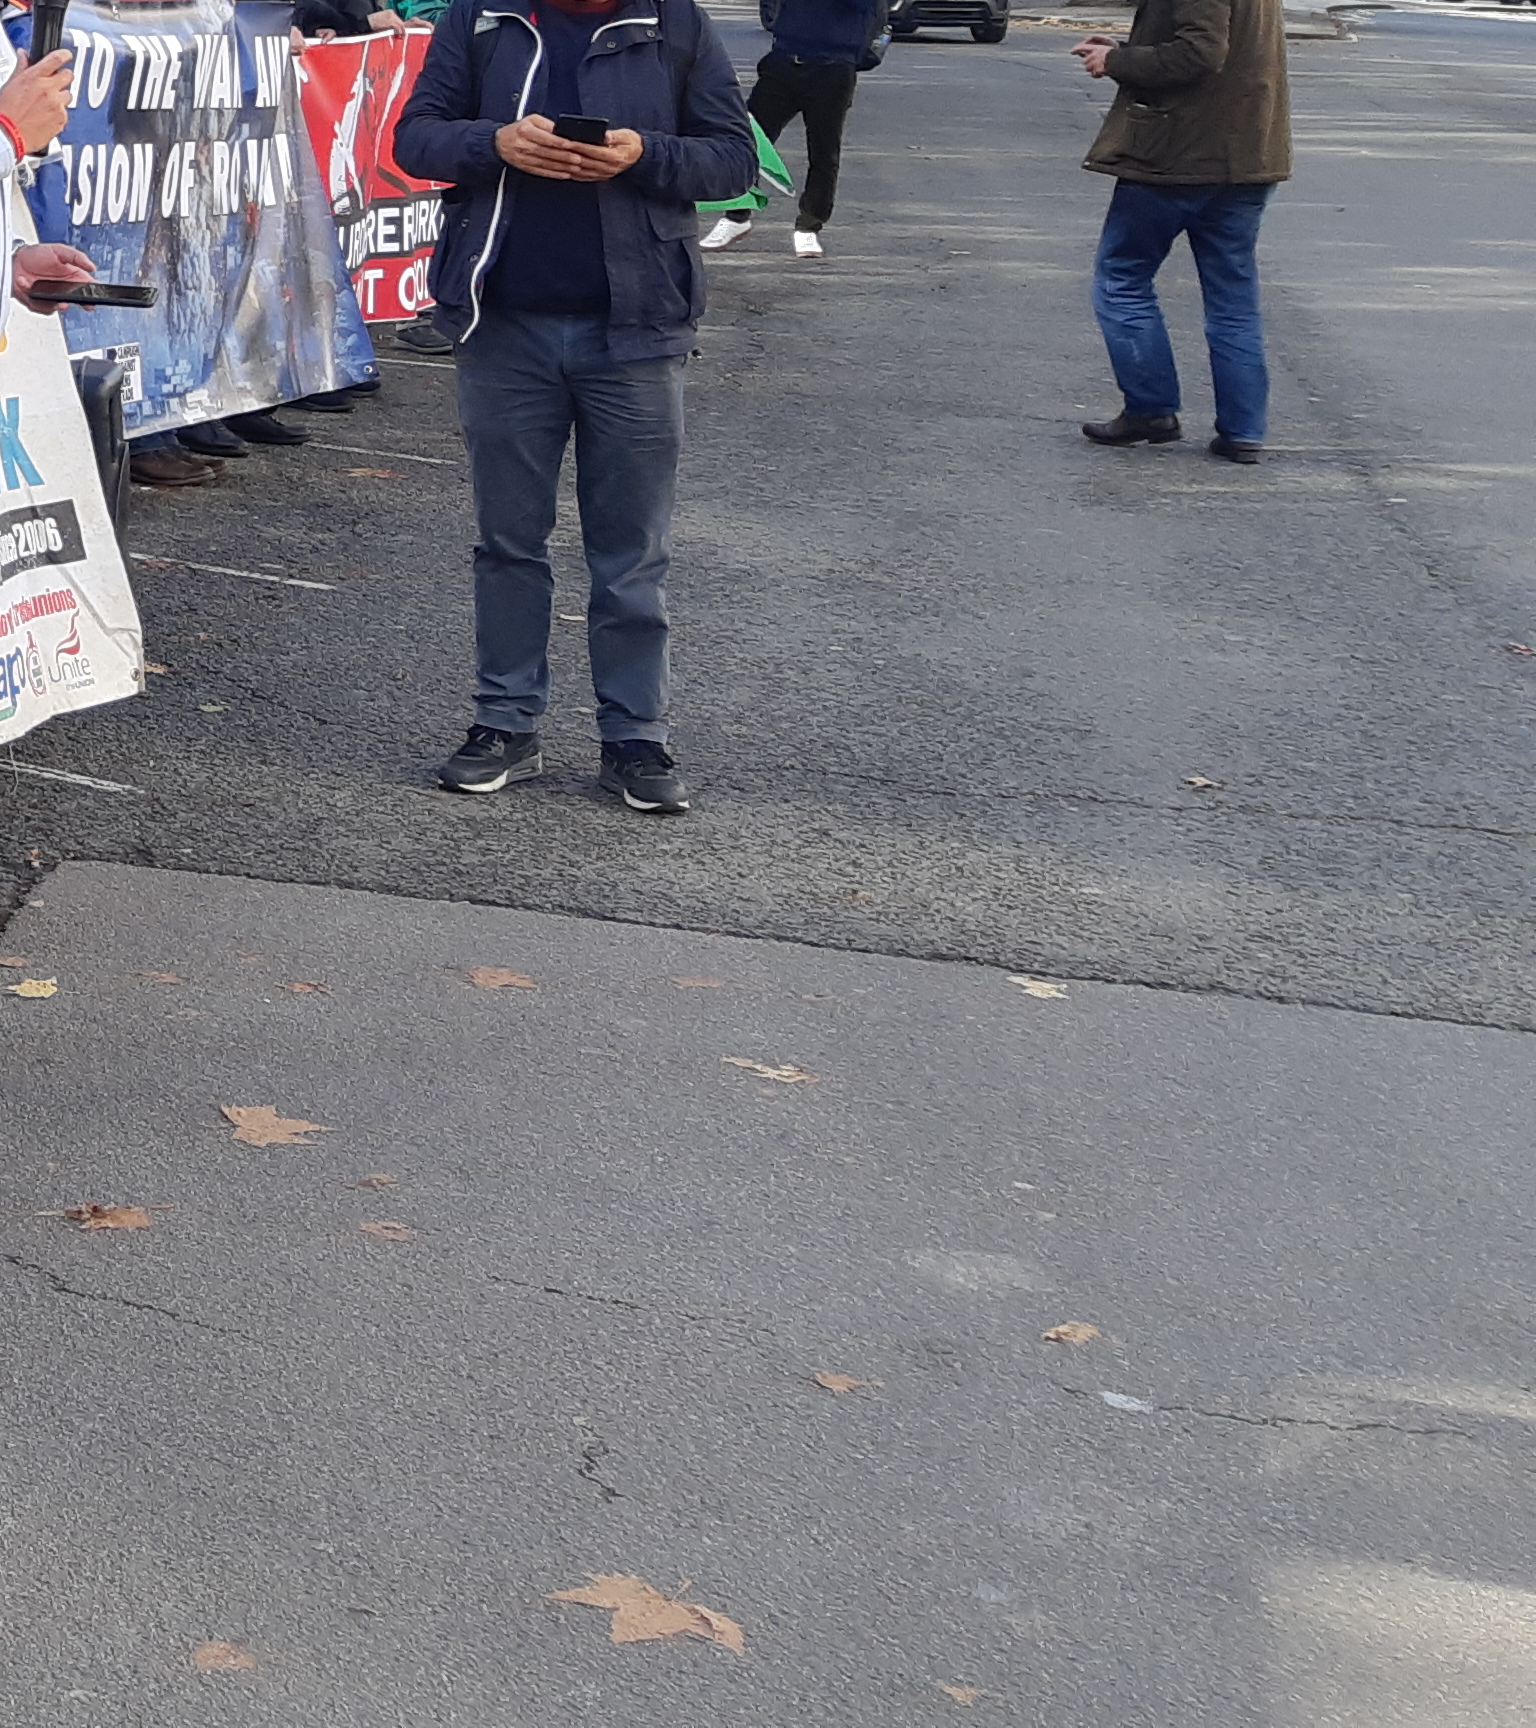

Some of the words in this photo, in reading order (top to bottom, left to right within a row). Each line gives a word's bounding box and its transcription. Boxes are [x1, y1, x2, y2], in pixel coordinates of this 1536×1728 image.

[68, 28, 115, 109] TO
[121, 34, 182, 110] THE
[161, 141, 196, 219] OF
[12, 517, 63, 557] 2006
